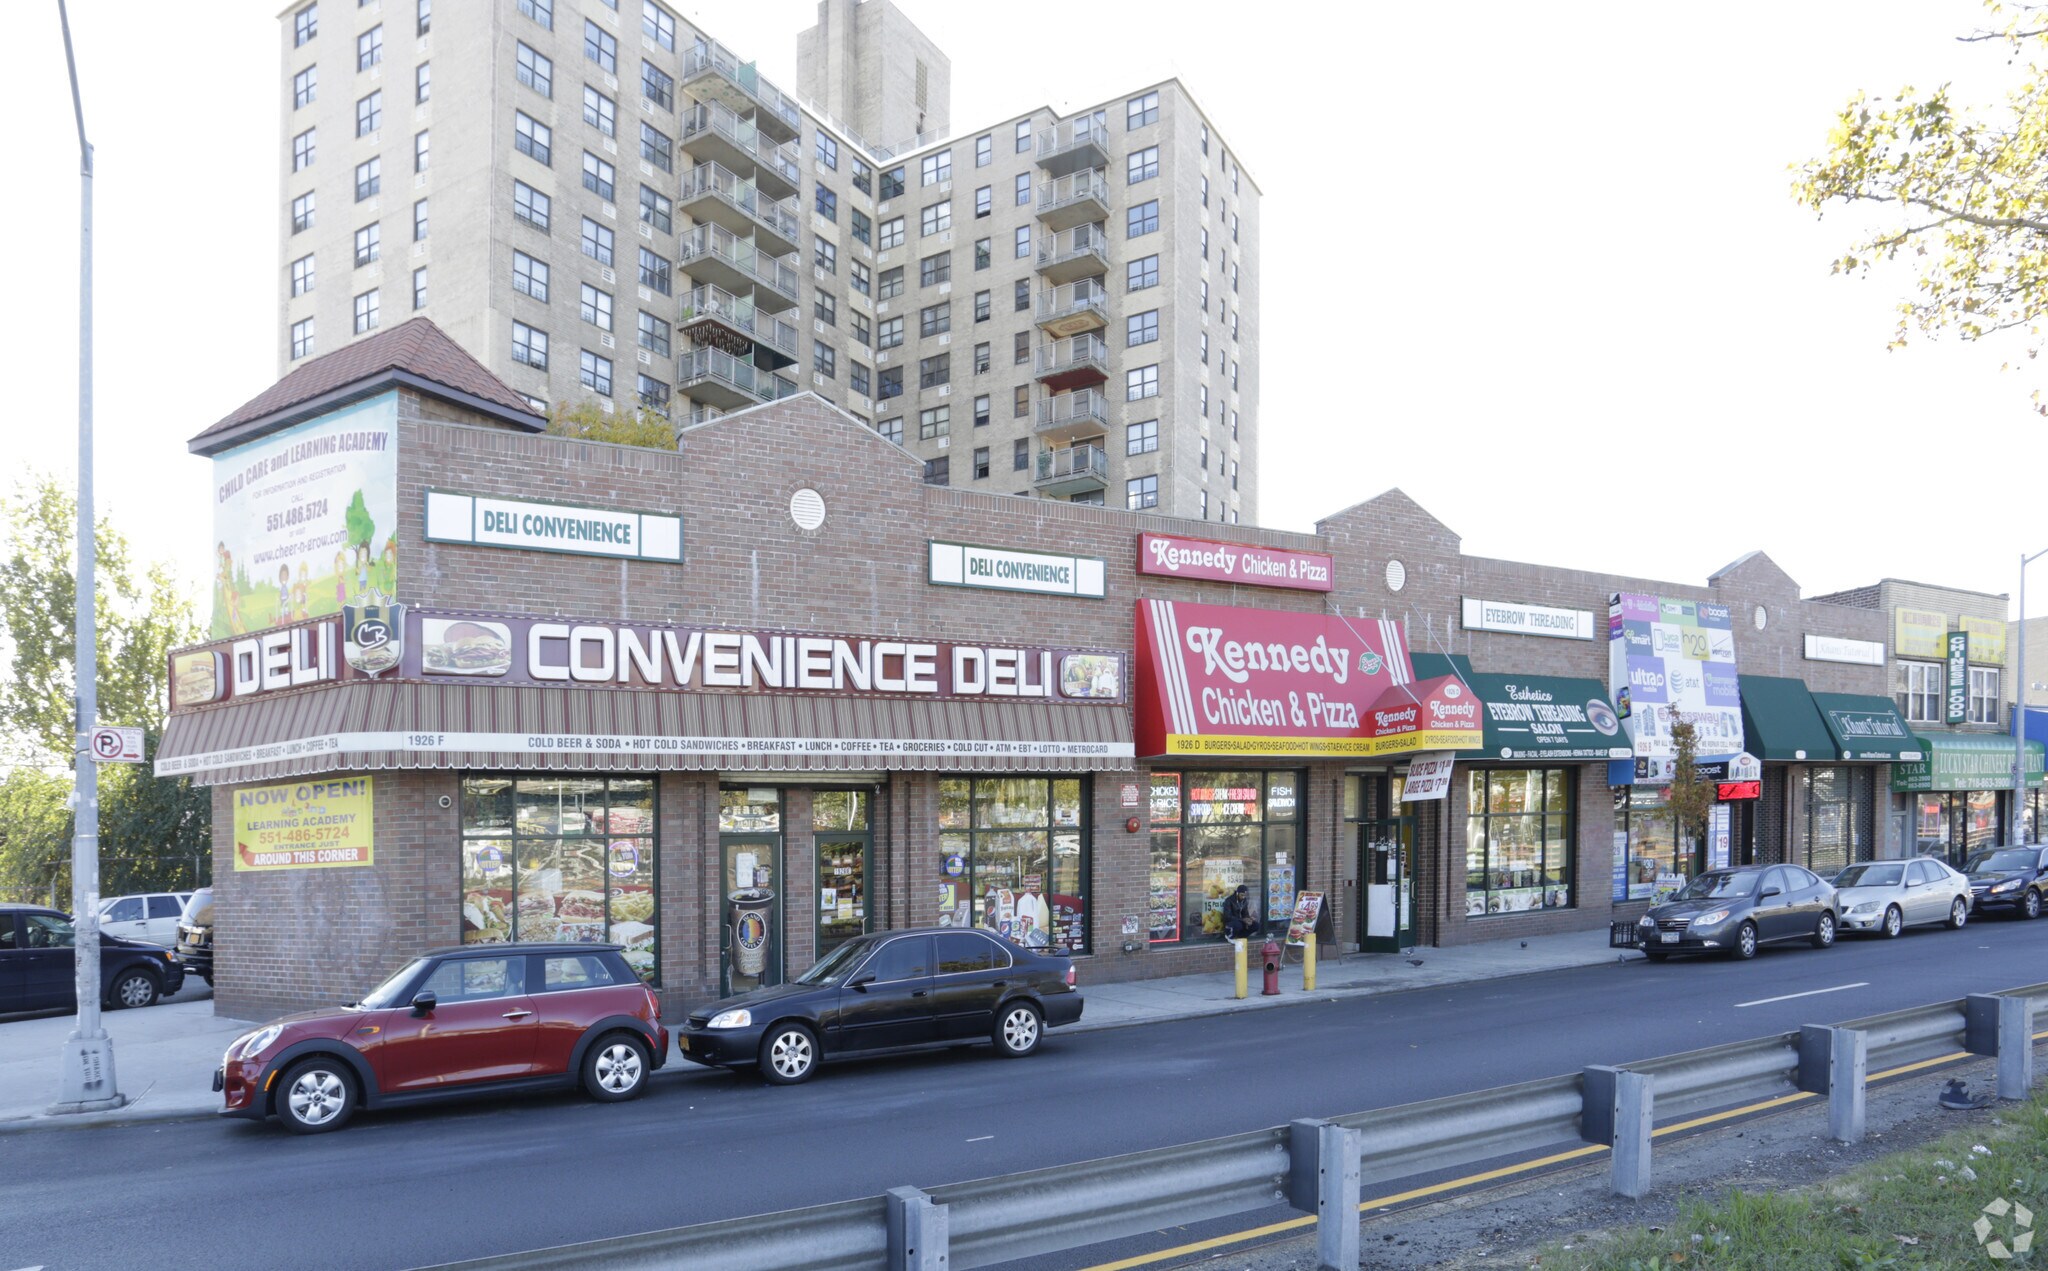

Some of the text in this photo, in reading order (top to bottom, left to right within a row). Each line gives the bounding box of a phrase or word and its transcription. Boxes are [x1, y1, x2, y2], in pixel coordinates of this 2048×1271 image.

[219, 431, 388, 503] CHILD CARE and LEARNING ACADEMY
[263, 480, 297, 496] INFORMATION
[309, 464, 347, 481] REGISTRATION
[291, 493, 304, 503] CALL
[267, 498, 328, 532] 551.486.5724
[483, 510, 631, 545] DELI CONVENIENCE
[253, 529, 348, 564] www.cheer-n-grow.com
[1150, 539, 1327, 582] Kennedy Chicken & Pizza
[970, 557, 1070, 584] DELI CONVENIENCE
[1485, 608, 1574, 630] EYEBROW THREADING
[1708, 607, 1729, 618] boost
[1632, 635, 1651, 645] smart
[1664, 632, 1679, 643] Lyca
[232, 622, 336, 695] DELI
[527, 623, 1052, 697] CONVENIENCE DELI
[1186, 626, 1350, 684] Kennedy
[1712, 648, 1732, 657] verizon
[1950, 636, 1965, 686] CHINESE
[1505, 685, 1552, 702] Esthetics
[1202, 686, 1360, 729] Chicken & Pizza
[1430, 701, 1475, 718] Kennedy
[1487, 702, 1586, 722] EYEBROW THREADING
[1949, 689, 1965, 717] FOOD
[1375, 707, 1416, 726] Kennedy
[1657, 707, 1719, 726] Exessway
[1866, 716, 1903, 735] Tutorial
[1375, 727, 1396, 735] Chicken
[1530, 723, 1564, 734] SALON
[408, 735, 444, 746] 1926 F
[528, 737, 1108, 754] COLD BEER & SODA HOT COLD SANDWICHES BREAKFAST LUNCH COFFEE TEA GROCERIES COLD CUT ATM EBT LOTTO METROCARD
[1177, 740, 1193, 750] 1926
[1353, 743, 1370, 752] CREAM
[160, 761, 171, 771] COLD
[172, 760, 182, 770] BEER
[188, 758, 199, 768] SODA
[203, 756, 211, 766] HOT
[212, 754, 223, 764] COLD
[224, 750, 252, 763] SANDWICHES
[256, 746, 281, 759] BREAKFAST
[287, 744, 302, 755] LUNCH
[306, 739, 324, 751] COFFEE
[329, 738, 338, 748] TEA
[1940, 753, 1962, 773] LUCKY
[1963, 753, 1979, 773] STAR
[1980, 753, 2006, 773] CHINESE
[2007, 753, 2045, 773] REURANT
[1424, 761, 1438, 775] PIZZA
[1900, 763, 1926, 775] STAR
[240, 780, 365, 807] NOW OPEN!
[1271, 787, 1292, 796] FISH
[1405, 779, 1434, 794] LARGE PIZZA
[247, 813, 356, 831] LEARNING ACADEMY
[259, 826, 350, 844] 551-486-5724
[274, 842, 316, 851] ENTRANCE
[253, 848, 358, 865] AROUND THIS CORNER
[1204, 902, 1212, 911] 15
